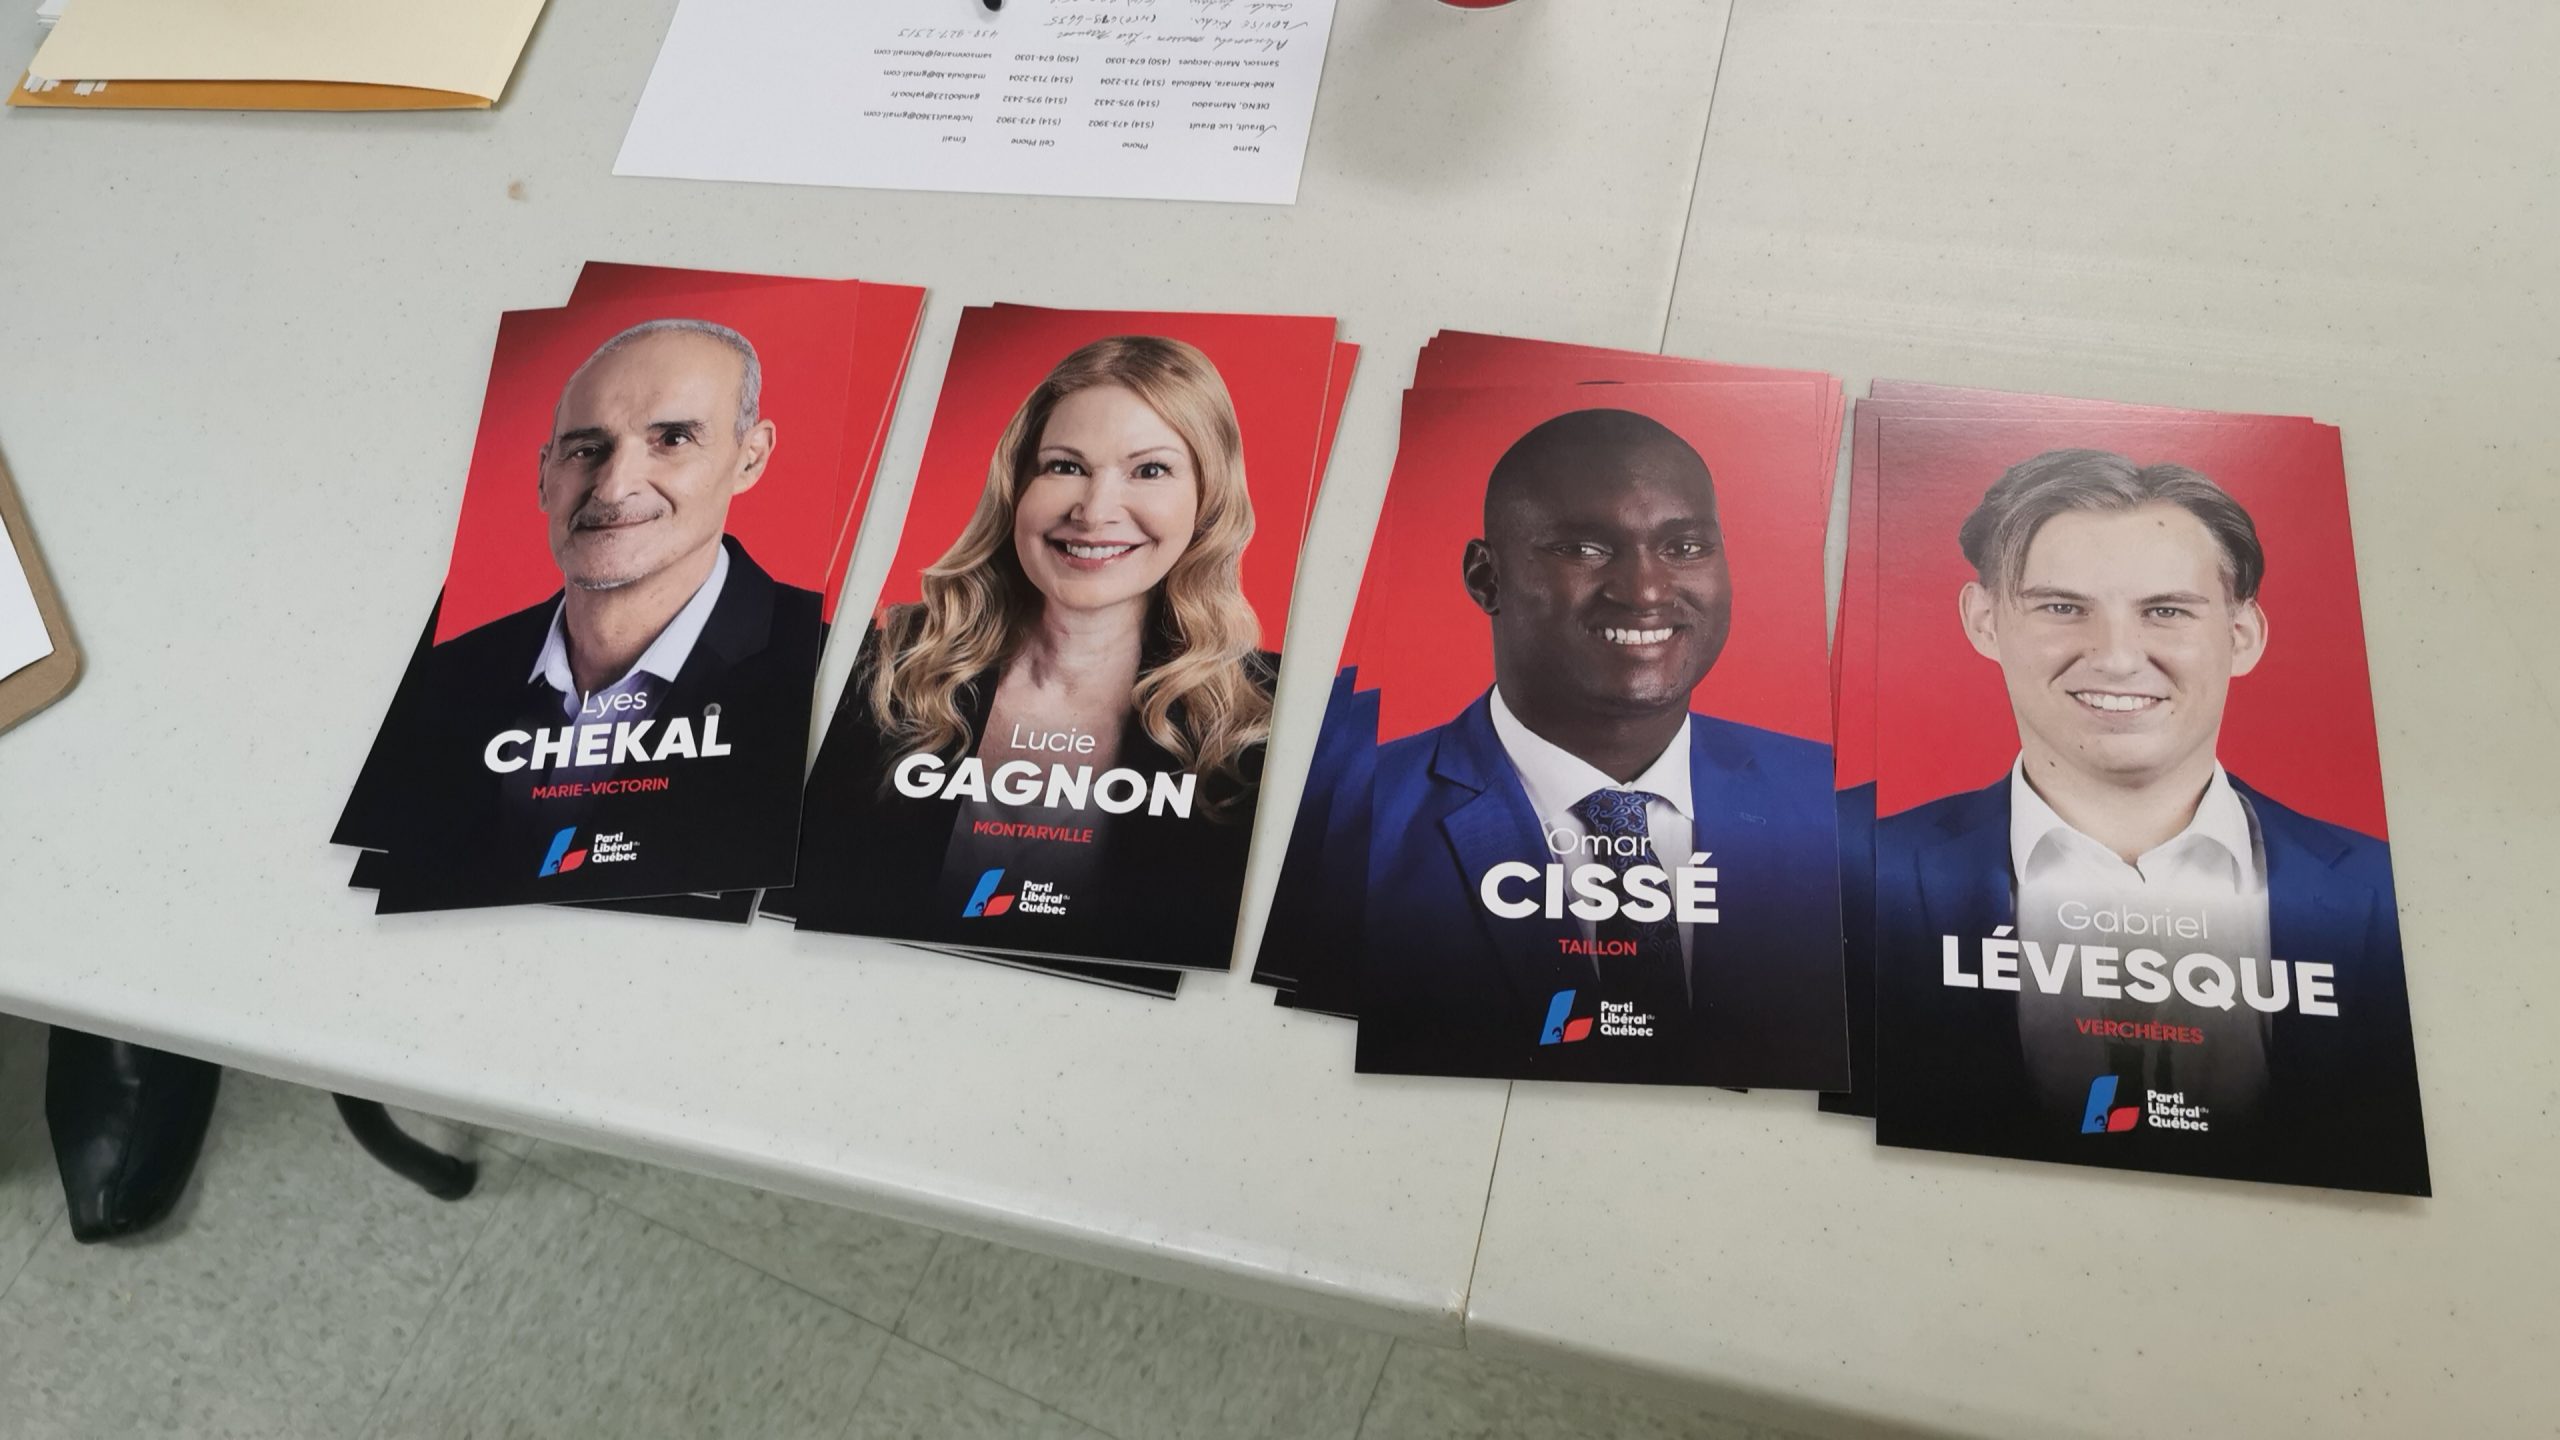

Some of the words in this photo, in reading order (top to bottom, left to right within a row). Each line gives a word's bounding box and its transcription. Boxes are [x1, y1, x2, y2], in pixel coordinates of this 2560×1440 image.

[1014, 54, 1055, 63] 674-1030
[1057, 54, 1079, 63] (450)
[1105, 57, 1146, 65] 674-1030
[1148, 57, 1171, 66] (450)
[1009, 74, 1048, 83] 713-2204
[1051, 75, 1074, 84] (514)
[1100, 78, 1140, 87] 713-2204
[1143, 78, 1165, 87] (514)
[1002, 95, 1042, 104] 975-2432
[1045, 96, 1067, 105] (514)
[1094, 98, 1135, 107] 975-2432
[1137, 99, 1160, 108] (514)
[1191, 101, 1237, 110] Mamadou
[1239, 102, 1270, 110] DIENG,
[996, 116, 1036, 126] 473-3902
[1038, 117, 1061, 126] (514)
[1088, 119, 1129, 129] 473-3902
[1131, 119, 1154, 129] (514)
[1189, 122, 1216, 131] Brault
[1218, 123, 1233, 131] Luc
[942, 136, 967, 144] Email
[1011, 138, 1036, 147] Phone
[1038, 139, 1055, 147] Cell
[1121, 142, 1148, 150] Phone
[1232, 145, 1260, 153] Name
[582, 690, 648, 719] Lyes
[1010, 723, 1096, 754] Lucie
[484, 715, 732, 774] CHEKAL
[532, 777, 669, 799] MARIE-VICTORIN
[894, 753, 1197, 819] GAGNON
[972, 820, 1094, 843] MONTARVILLE
[594, 832, 624, 843] Parti
[1548, 827, 1652, 857] Omar
[593, 840, 634, 853] Libéral
[592, 851, 638, 864] Québec
[1023, 880, 1053, 892] Parti
[1480, 852, 1719, 923] CISSÉ
[1020, 890, 1063, 904] Libéral
[1019, 900, 1066, 916] Québec
[2057, 901, 2208, 940] Gabriel
[1558, 938, 1637, 956] TAILLON
[1942, 925, 2339, 1018] LÉVESQUE
[1600, 1001, 1633, 1013] Parti
[1600, 1012, 1647, 1025] Libéral
[1600, 1023, 1654, 1037] Québec
[2075, 1018, 2205, 1045] VERCHÈRES
[2146, 1089, 2184, 1105] Parti
[2147, 1102, 2200, 1118] Libéral
[2148, 1115, 2209, 1132] Québec
